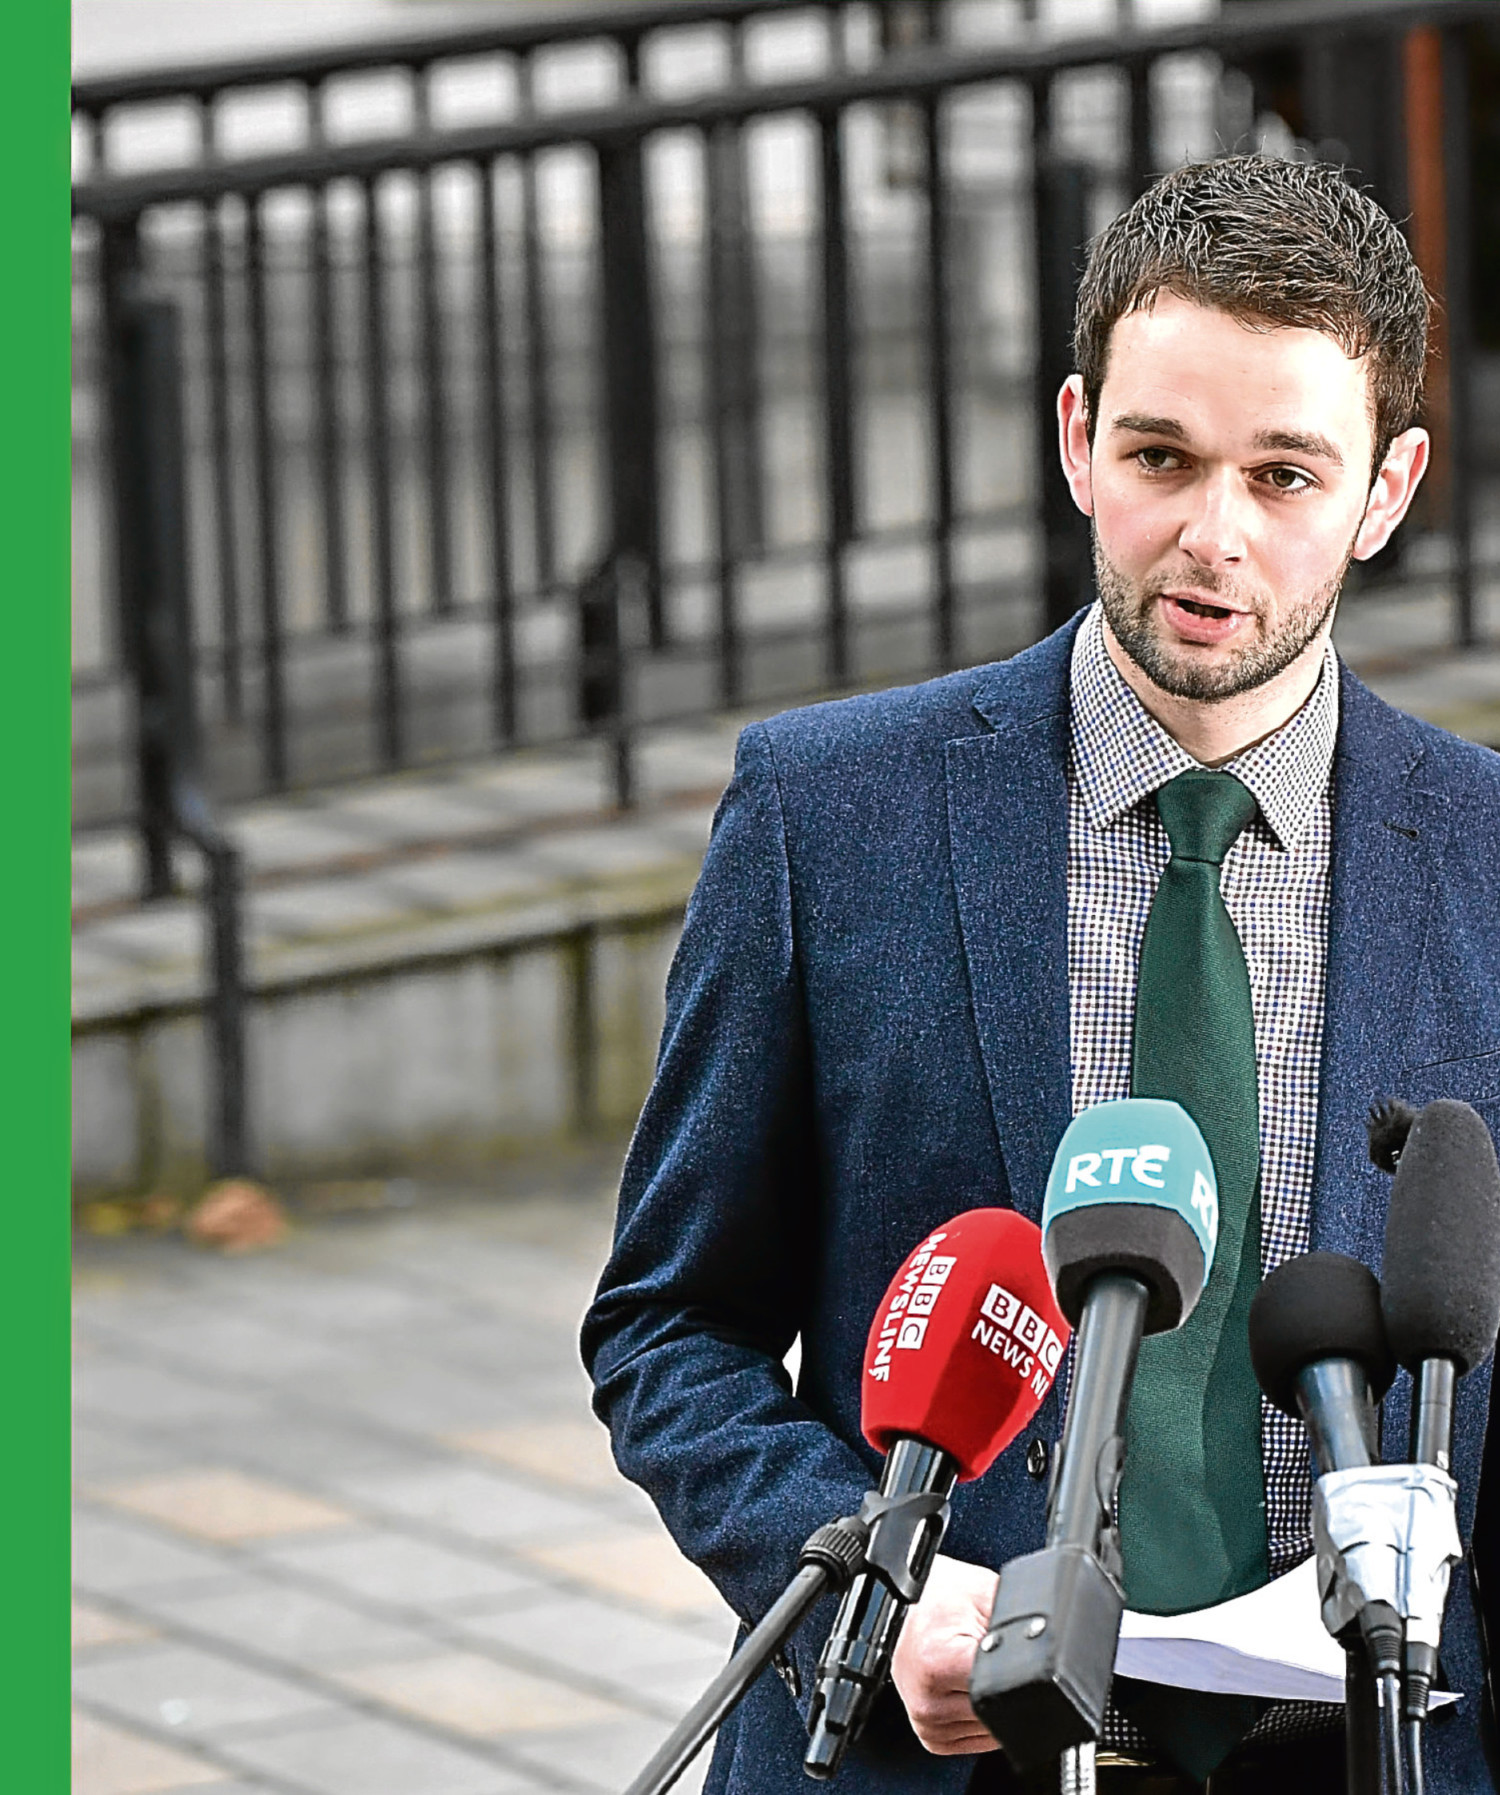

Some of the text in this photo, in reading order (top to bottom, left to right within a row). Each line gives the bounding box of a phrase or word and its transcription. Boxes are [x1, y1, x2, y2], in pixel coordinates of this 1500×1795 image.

[894, 1257, 956, 1349] BBC
[971, 1319, 1035, 1378] NEWS
[980, 1283, 1064, 1377] BBC
